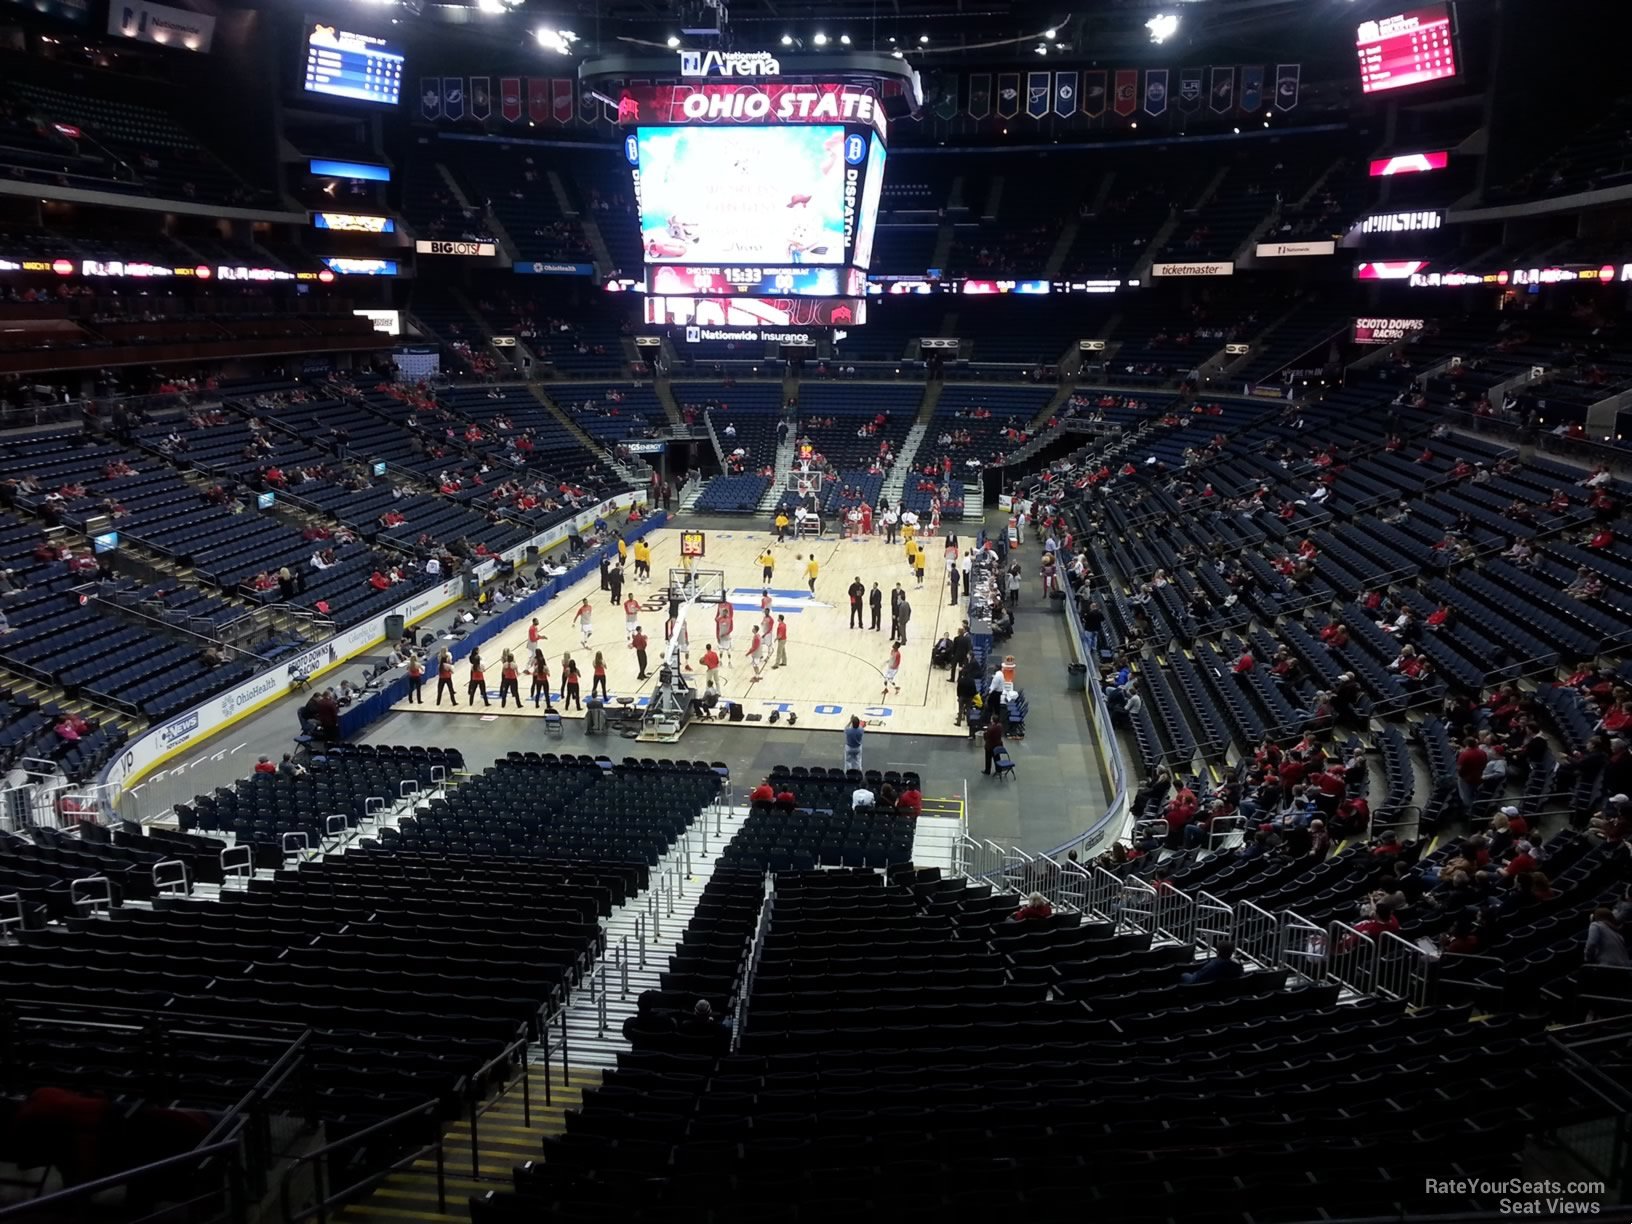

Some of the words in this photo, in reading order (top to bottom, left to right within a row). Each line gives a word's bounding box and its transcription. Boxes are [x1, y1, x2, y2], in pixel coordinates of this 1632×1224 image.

[152, 16, 199, 34] Nationwide
[700, 51, 780, 76] Arena
[722, 51, 772, 61] Nationwide
[683, 92, 770, 118] OHIO
[777, 92, 873, 119] STATE
[844, 169, 859, 248] DISPATCH
[724, 268, 762, 282] 15:33
[1162, 264, 1219, 275] ticketmaster
[1356, 318, 1389, 329] SCIOTO
[1388, 319, 1425, 330] DOWNS
[701, 329, 757, 341] Nationwide
[761, 330, 809, 342] Insurance
[1372, 329, 1403, 339] RACINO
[308, 644, 329, 663] DOWNS
[236, 678, 277, 706] OhioHealth
[169, 716, 197, 736] NEWS
[120, 750, 134, 778] yp
